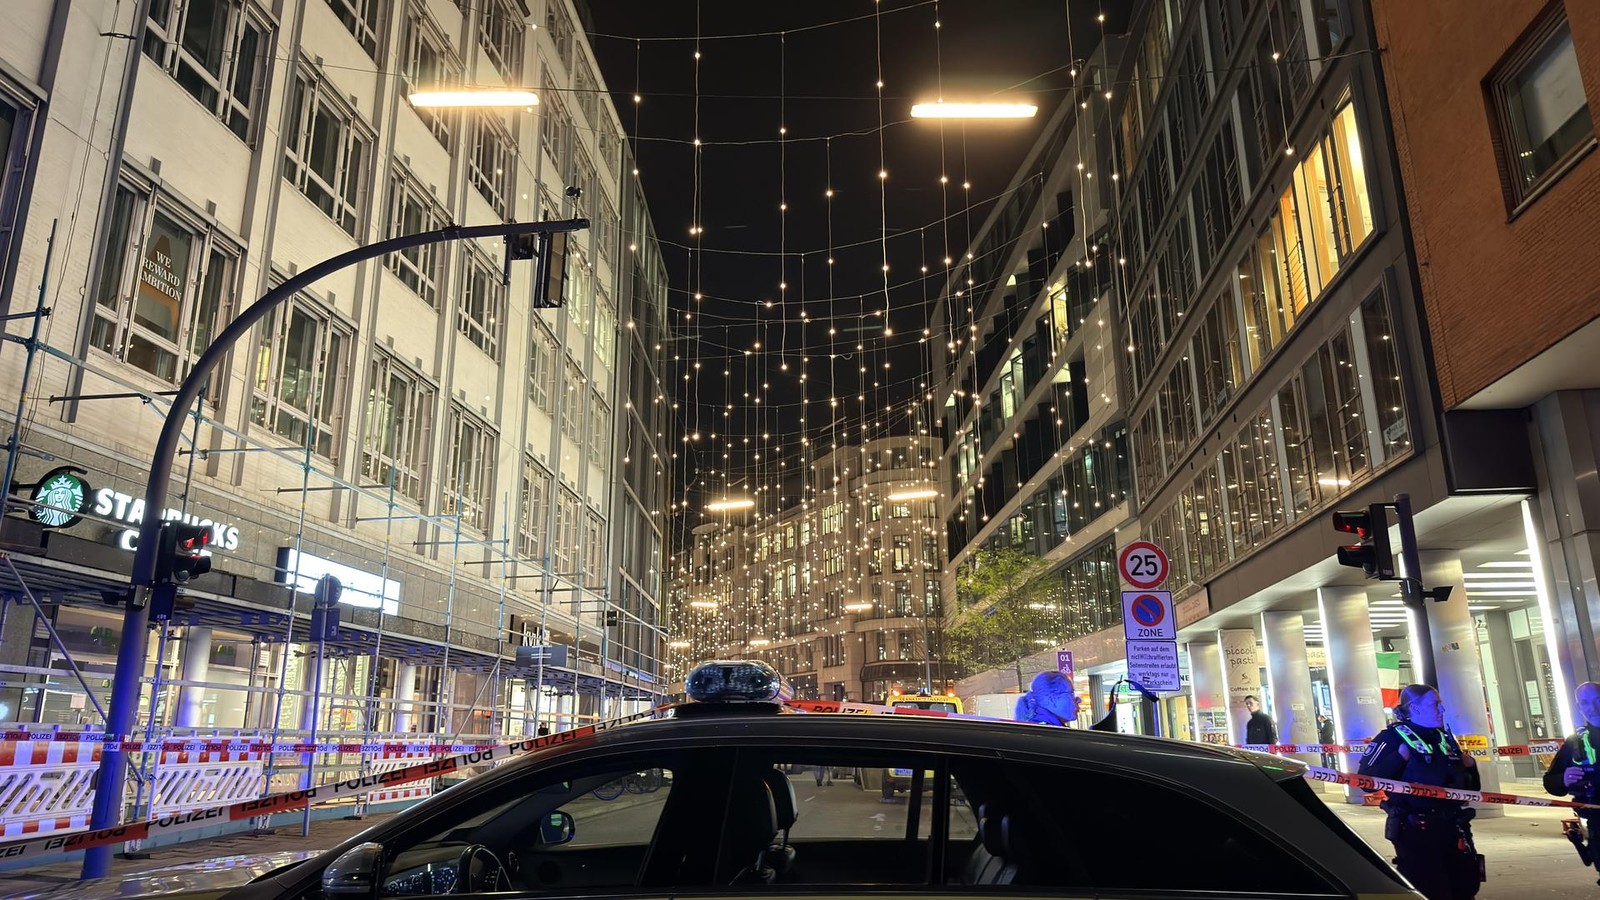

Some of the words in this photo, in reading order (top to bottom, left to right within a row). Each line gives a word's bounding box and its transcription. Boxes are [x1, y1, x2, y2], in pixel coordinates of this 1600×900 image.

[156, 250, 172, 269] WE
[144, 257, 180, 287] REWARD
[141, 271, 182, 302] MBITION
[95, 488, 239, 551] STAKS
[1130, 554, 1158, 576] 25
[1138, 628, 1164, 638] ZONE
[1230, 655, 1255, 668] pasti
[1275, 745, 1302, 754] POLIZEI
[1492, 746, 1523, 756] POLIZEI
[1529, 743, 1560, 755] POLIZEI
[44, 828, 126, 851] POLIZEI
[145, 806, 225, 831] POLIZEI
[241, 788, 317, 812] POLIZEI
[334, 769, 406, 793] POLIZEI
[423, 749, 493, 775] POLIZEI
[509, 731, 578, 755] POLIZEI
